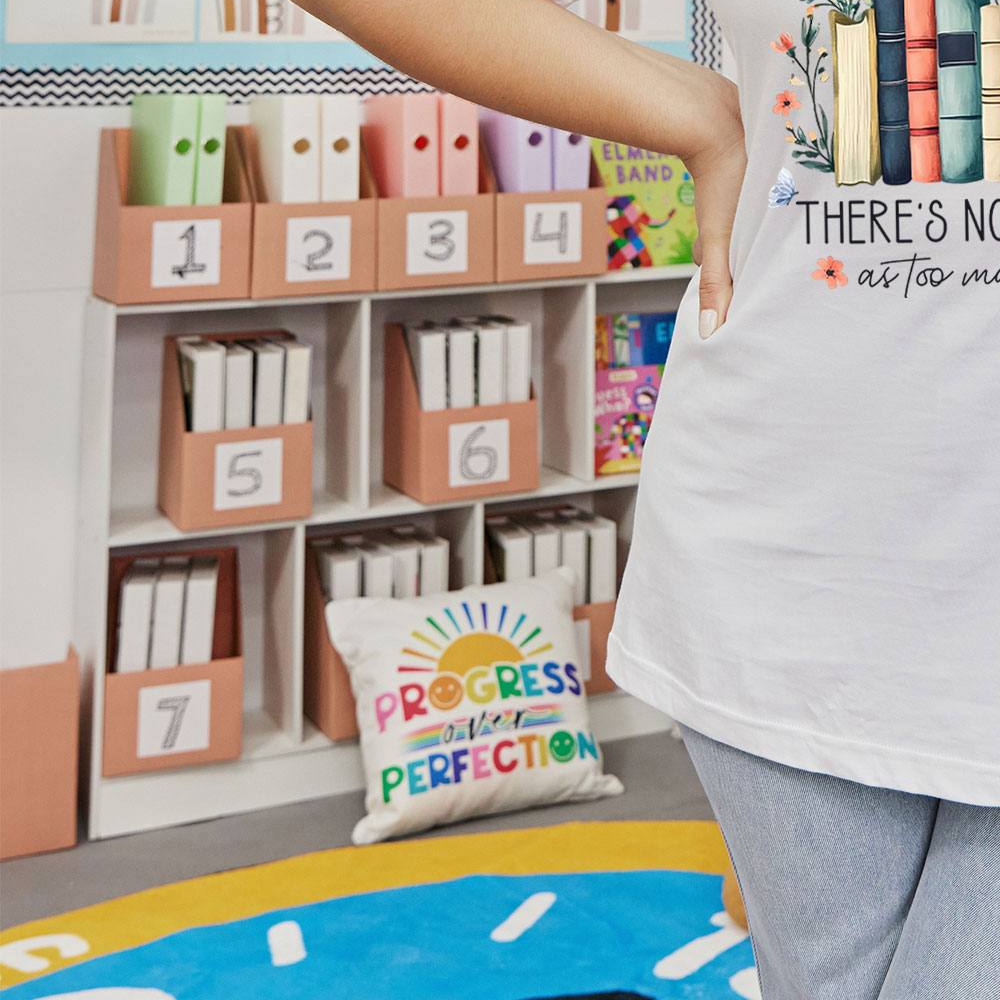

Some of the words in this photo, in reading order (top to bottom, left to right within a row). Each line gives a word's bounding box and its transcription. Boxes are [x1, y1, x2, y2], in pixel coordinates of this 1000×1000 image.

[615, 164, 674, 185] BAND
[424, 218, 457, 262] 3
[531, 210, 567, 254] 4
[796, 200, 947, 244] THERE'S
[172, 224, 207, 279] 1
[299, 229, 334, 271] 2
[858, 267, 899, 288] as
[227, 449, 263, 497] 5
[459, 425, 498, 481] 6
[375, 662, 582, 733] PROGRESS
[156, 695, 192, 751] 7
[442, 709, 529, 744] over
[381, 730, 600, 804] PERFECTION
